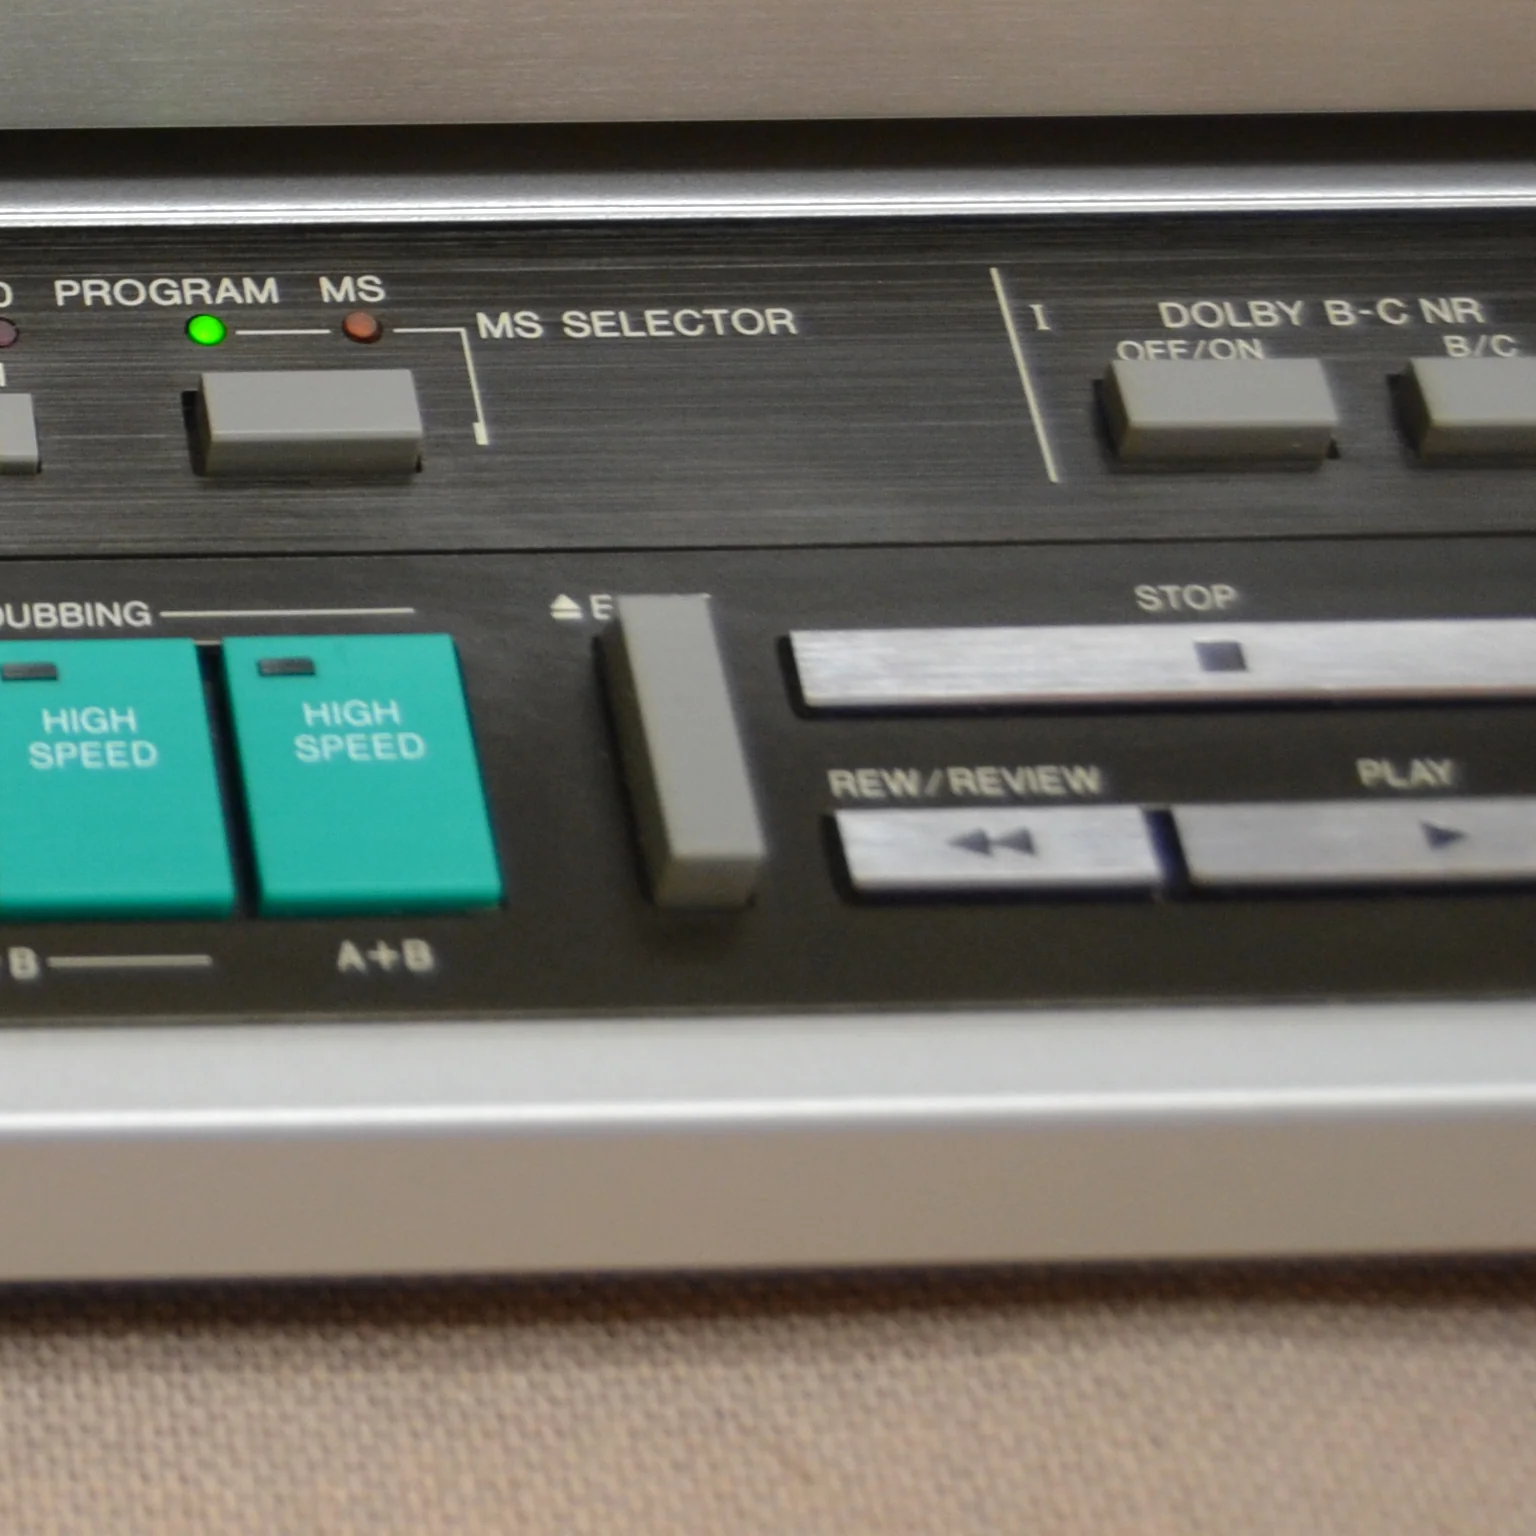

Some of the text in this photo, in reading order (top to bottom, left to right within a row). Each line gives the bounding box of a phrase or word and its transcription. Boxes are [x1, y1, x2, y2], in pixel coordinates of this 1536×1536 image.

[54, 277, 280, 307] PROGRAM
[319, 275, 386, 303] MS
[476, 307, 798, 339] MS SELECTOR
[1158, 300, 1303, 329] DOLBY
[1418, 296, 1486, 324] NR
[1116, 339, 1266, 361] OFF/ON
[1442, 335, 1521, 359] B/C
[1134, 583, 1238, 612] STOP
[42, 706, 137, 735] HIGH
[302, 699, 401, 727] HIGH
[28, 740, 158, 770] SPEED
[294, 732, 426, 763] SPEED
[828, 765, 1101, 799] REW/REVIEW
[1357, 758, 1453, 789] PLAY
[8, 946, 40, 980] B
